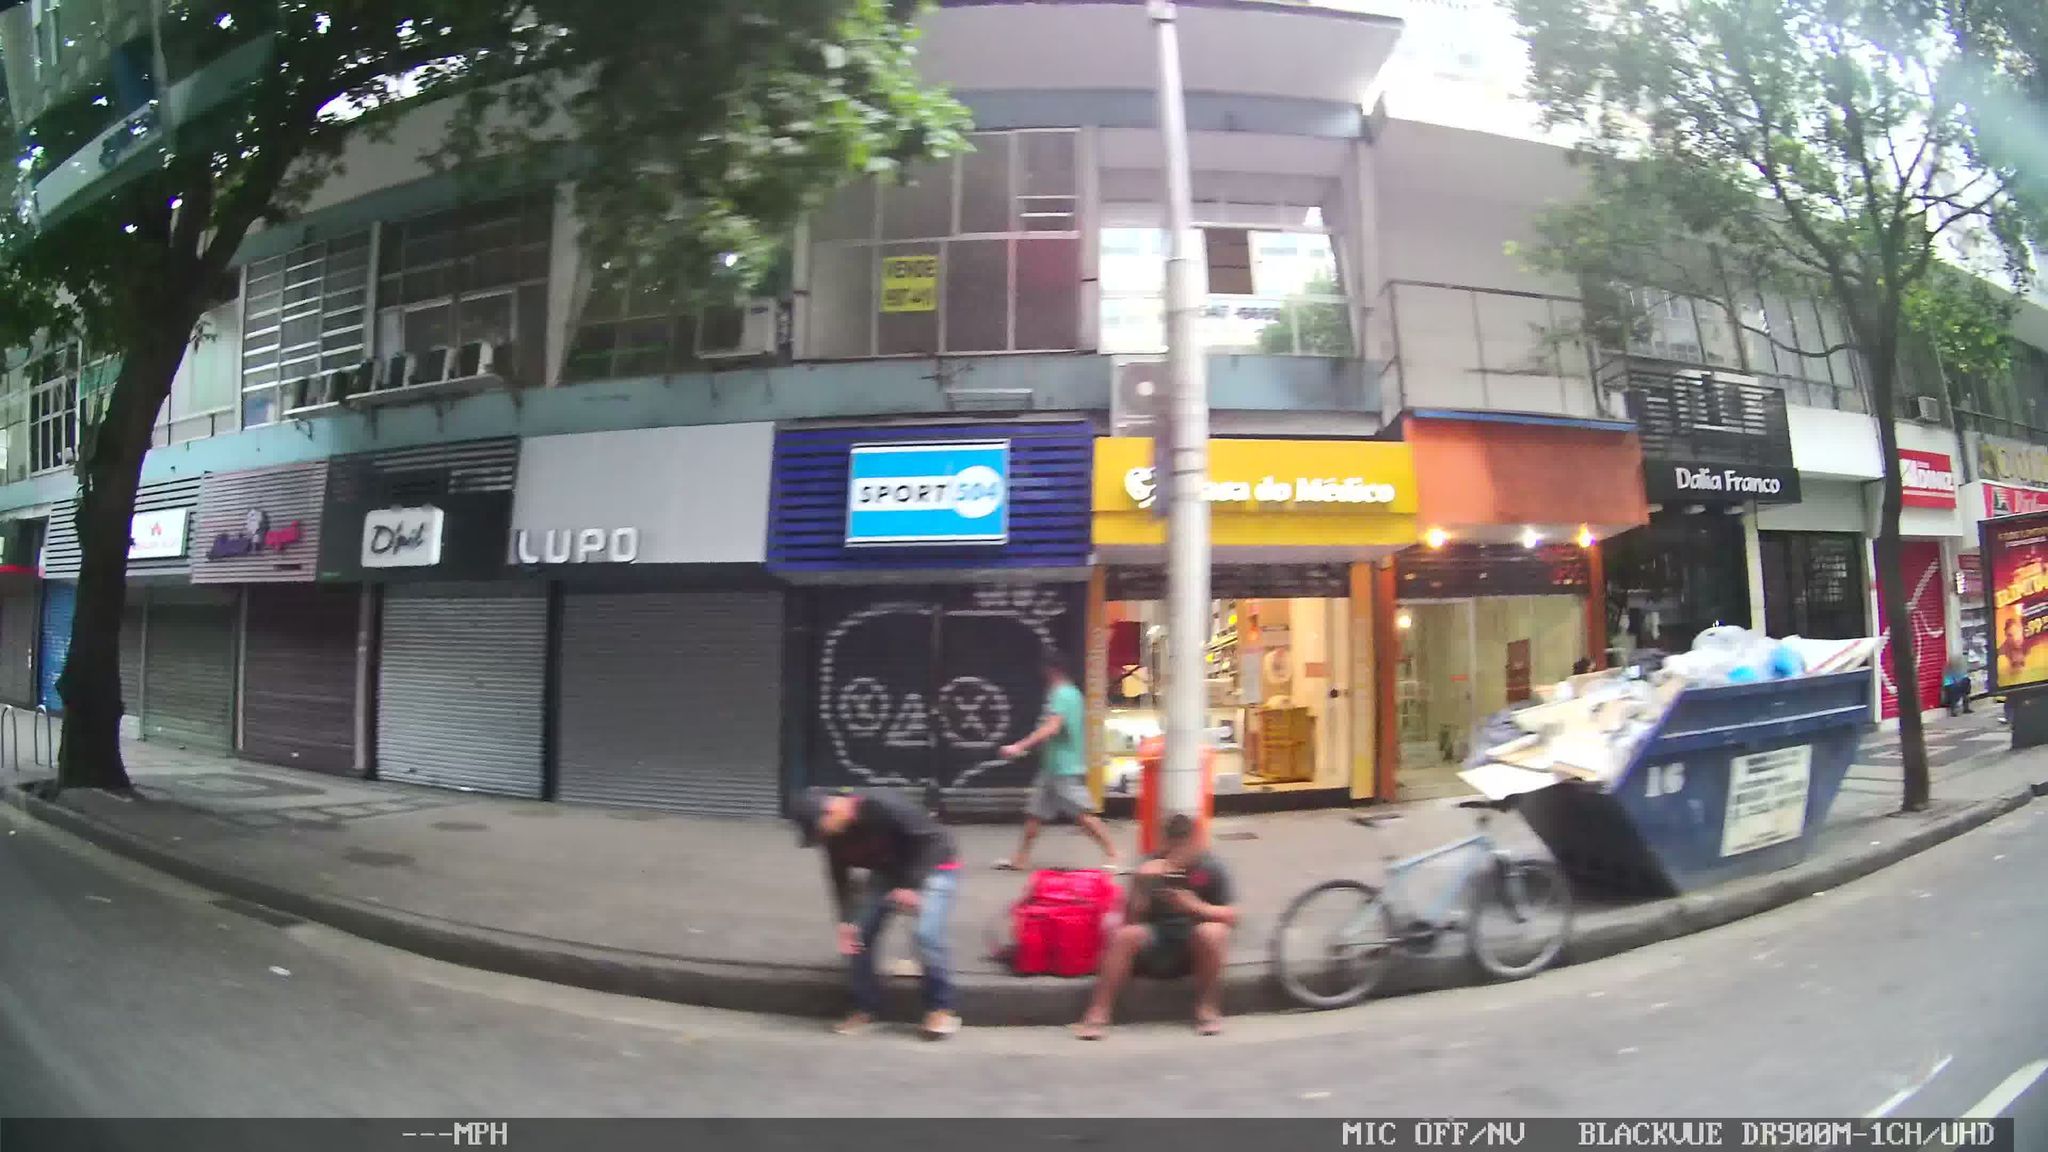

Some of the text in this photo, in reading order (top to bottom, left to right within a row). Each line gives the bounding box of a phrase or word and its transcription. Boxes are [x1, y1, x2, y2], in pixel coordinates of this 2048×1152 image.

[859, 484, 947, 503] SPORT
[1724, 470, 1781, 494] Franco
[517, 527, 638, 564] LUPO
